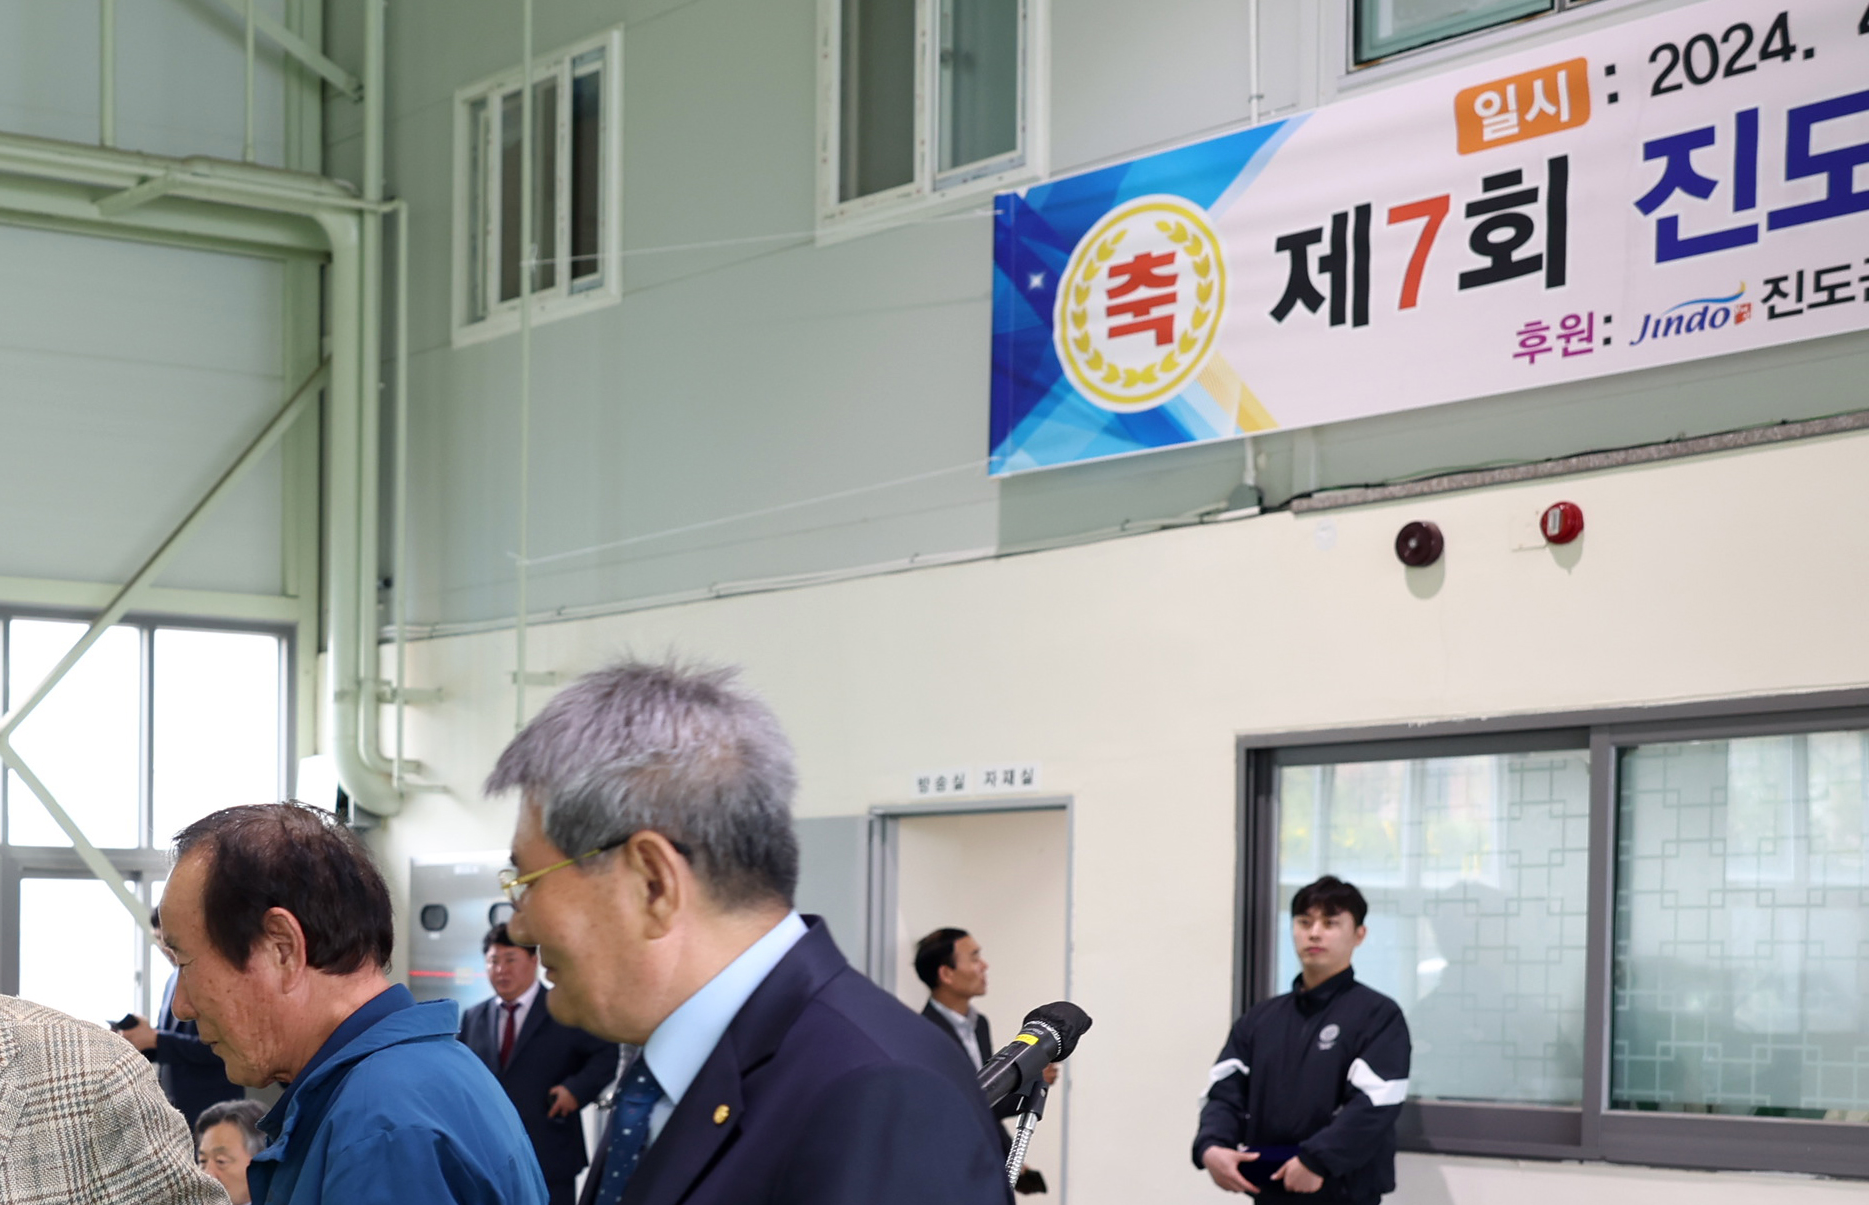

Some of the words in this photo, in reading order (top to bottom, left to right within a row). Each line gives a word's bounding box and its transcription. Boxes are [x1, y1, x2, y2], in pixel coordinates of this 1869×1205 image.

[1473, 69, 1571, 142] 일시
[1648, 10, 1816, 98] 2024.
[1104, 248, 1180, 347] 축
[1269, 153, 1570, 329] 제7회
[1629, 303, 1731, 346] Jindo
[1760, 257, 1869, 322] 진도
